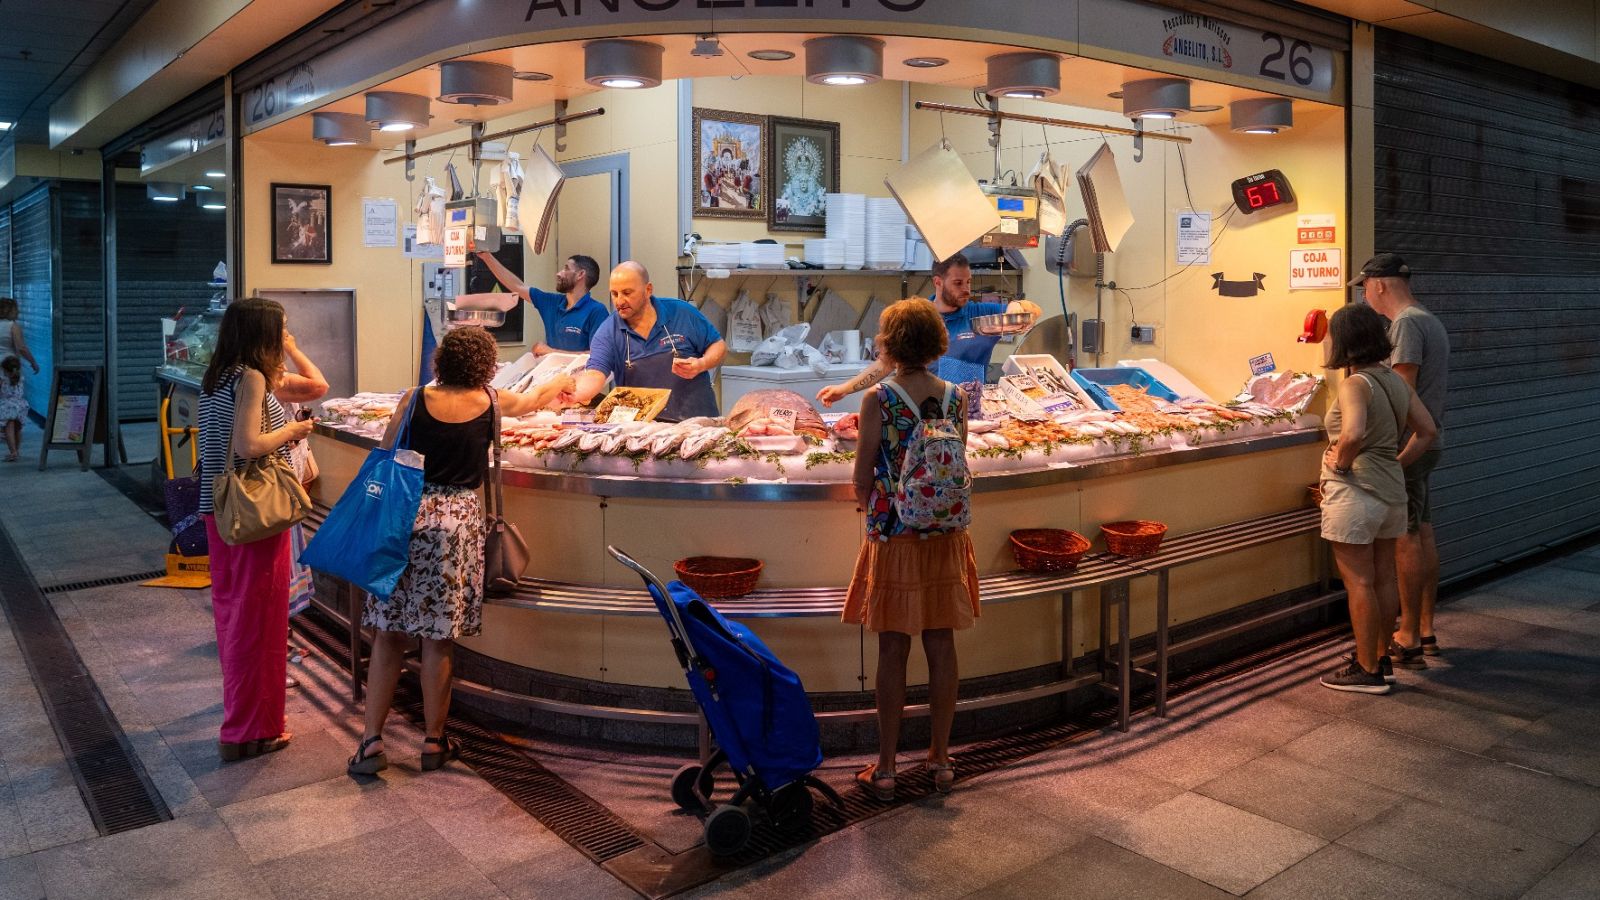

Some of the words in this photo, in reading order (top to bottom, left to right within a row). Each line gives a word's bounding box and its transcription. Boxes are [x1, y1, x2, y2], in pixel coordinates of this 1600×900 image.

[1162, 13, 1194, 32] Pescados
[1202, 15, 1231, 45] Mariscos
[1260, 32, 1314, 85] 26
[252, 80, 276, 122] 26
[207, 109, 225, 141] 25
[1247, 182, 1279, 208] 67
[1292, 268, 1305, 278] SU
[1307, 267, 1340, 278] TURNO
[1303, 252, 1328, 263] COJA
